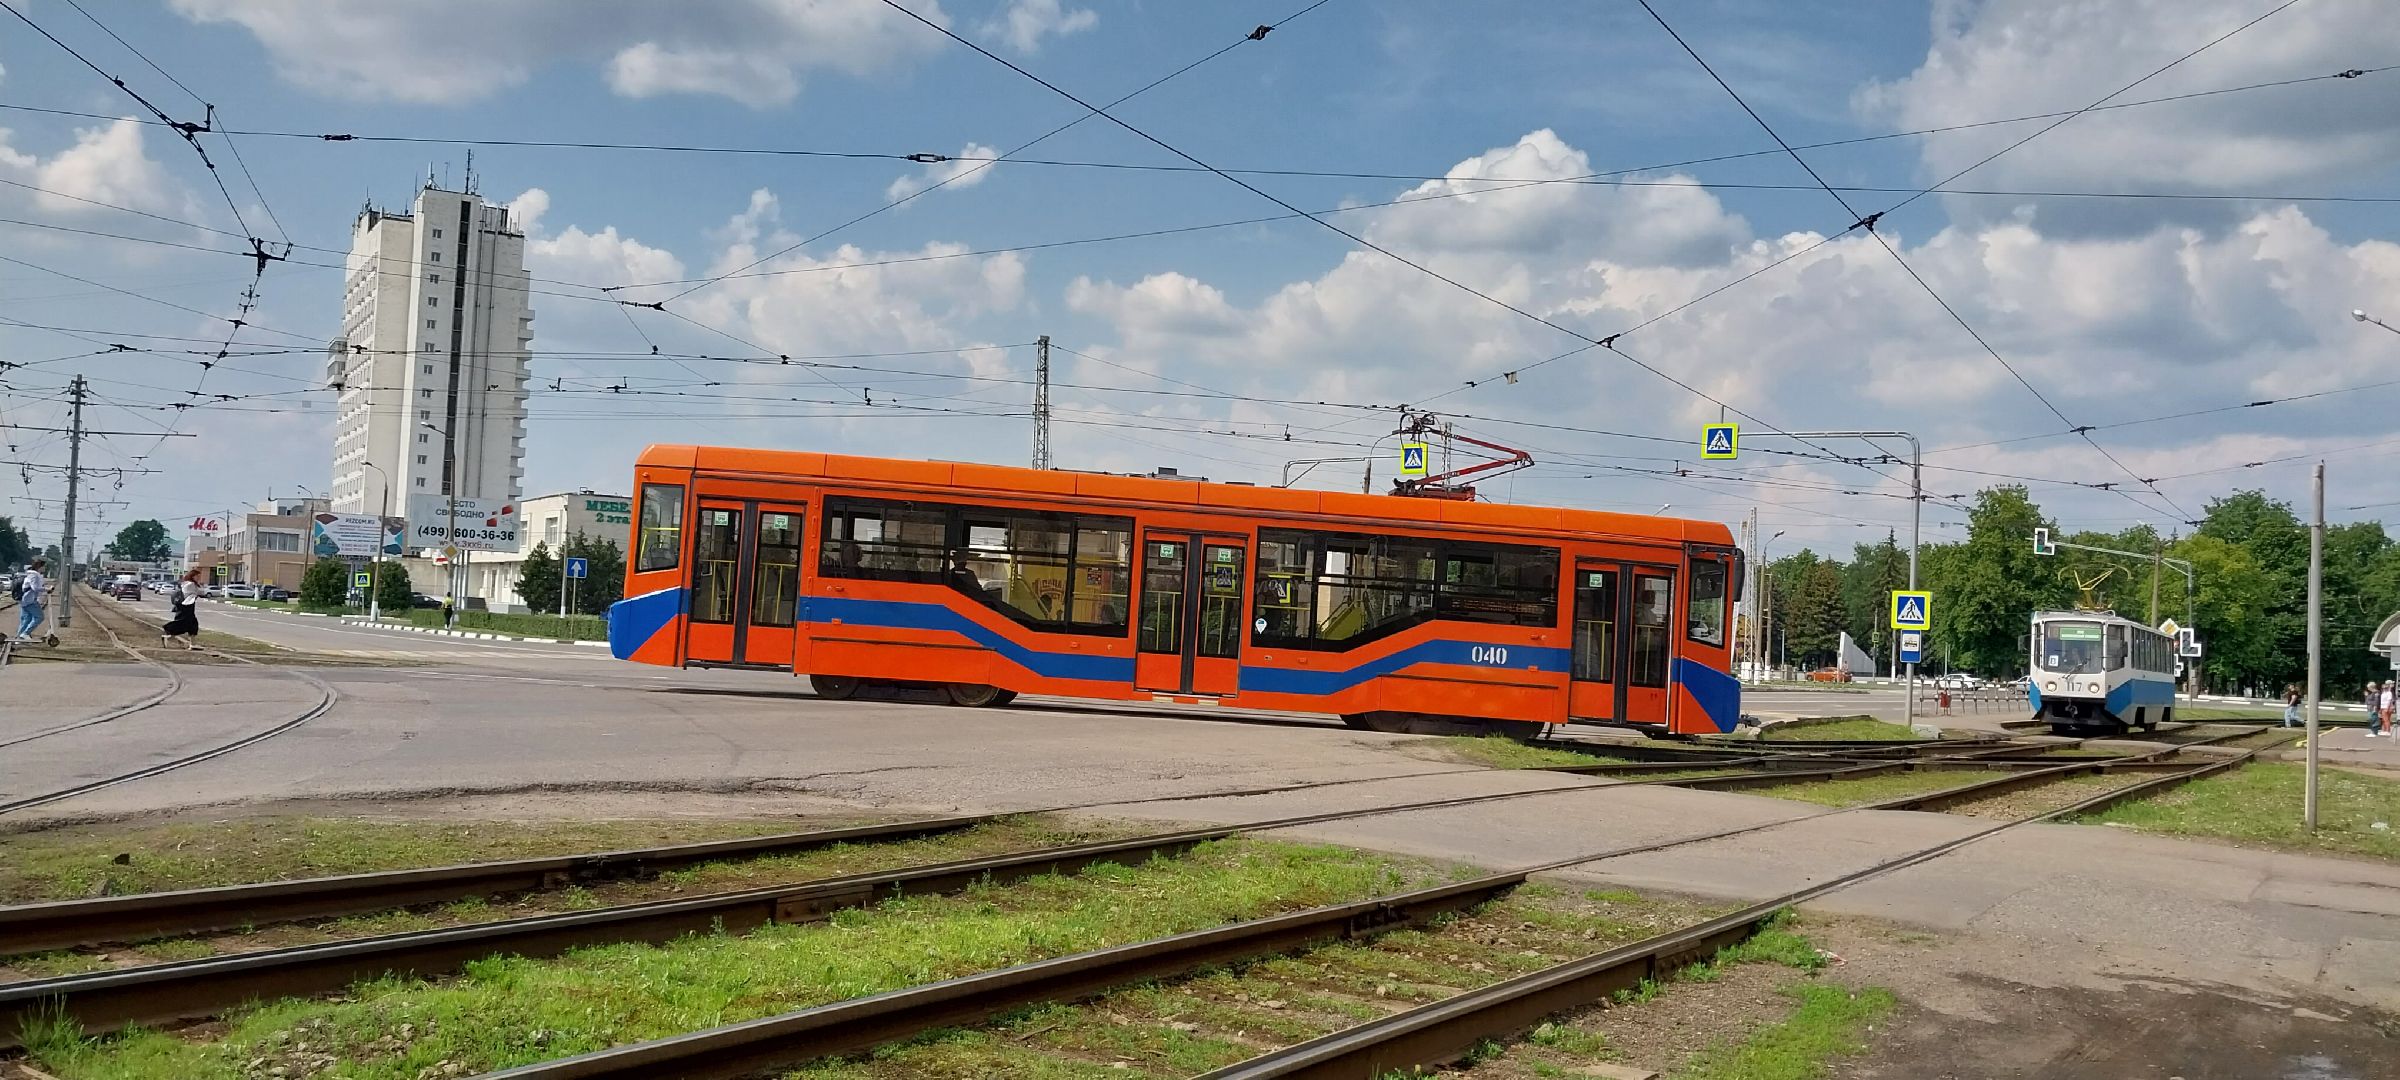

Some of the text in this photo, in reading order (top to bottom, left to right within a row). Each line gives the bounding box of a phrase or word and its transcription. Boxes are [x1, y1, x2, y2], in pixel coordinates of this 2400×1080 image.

[435, 508, 485, 519] СВБОДНО
[596, 512, 604, 523] 2
[417, 525, 515, 541] (499) 600-36-36
[1471, 646, 1508, 665] 040
[2066, 681, 2083, 692] 117
